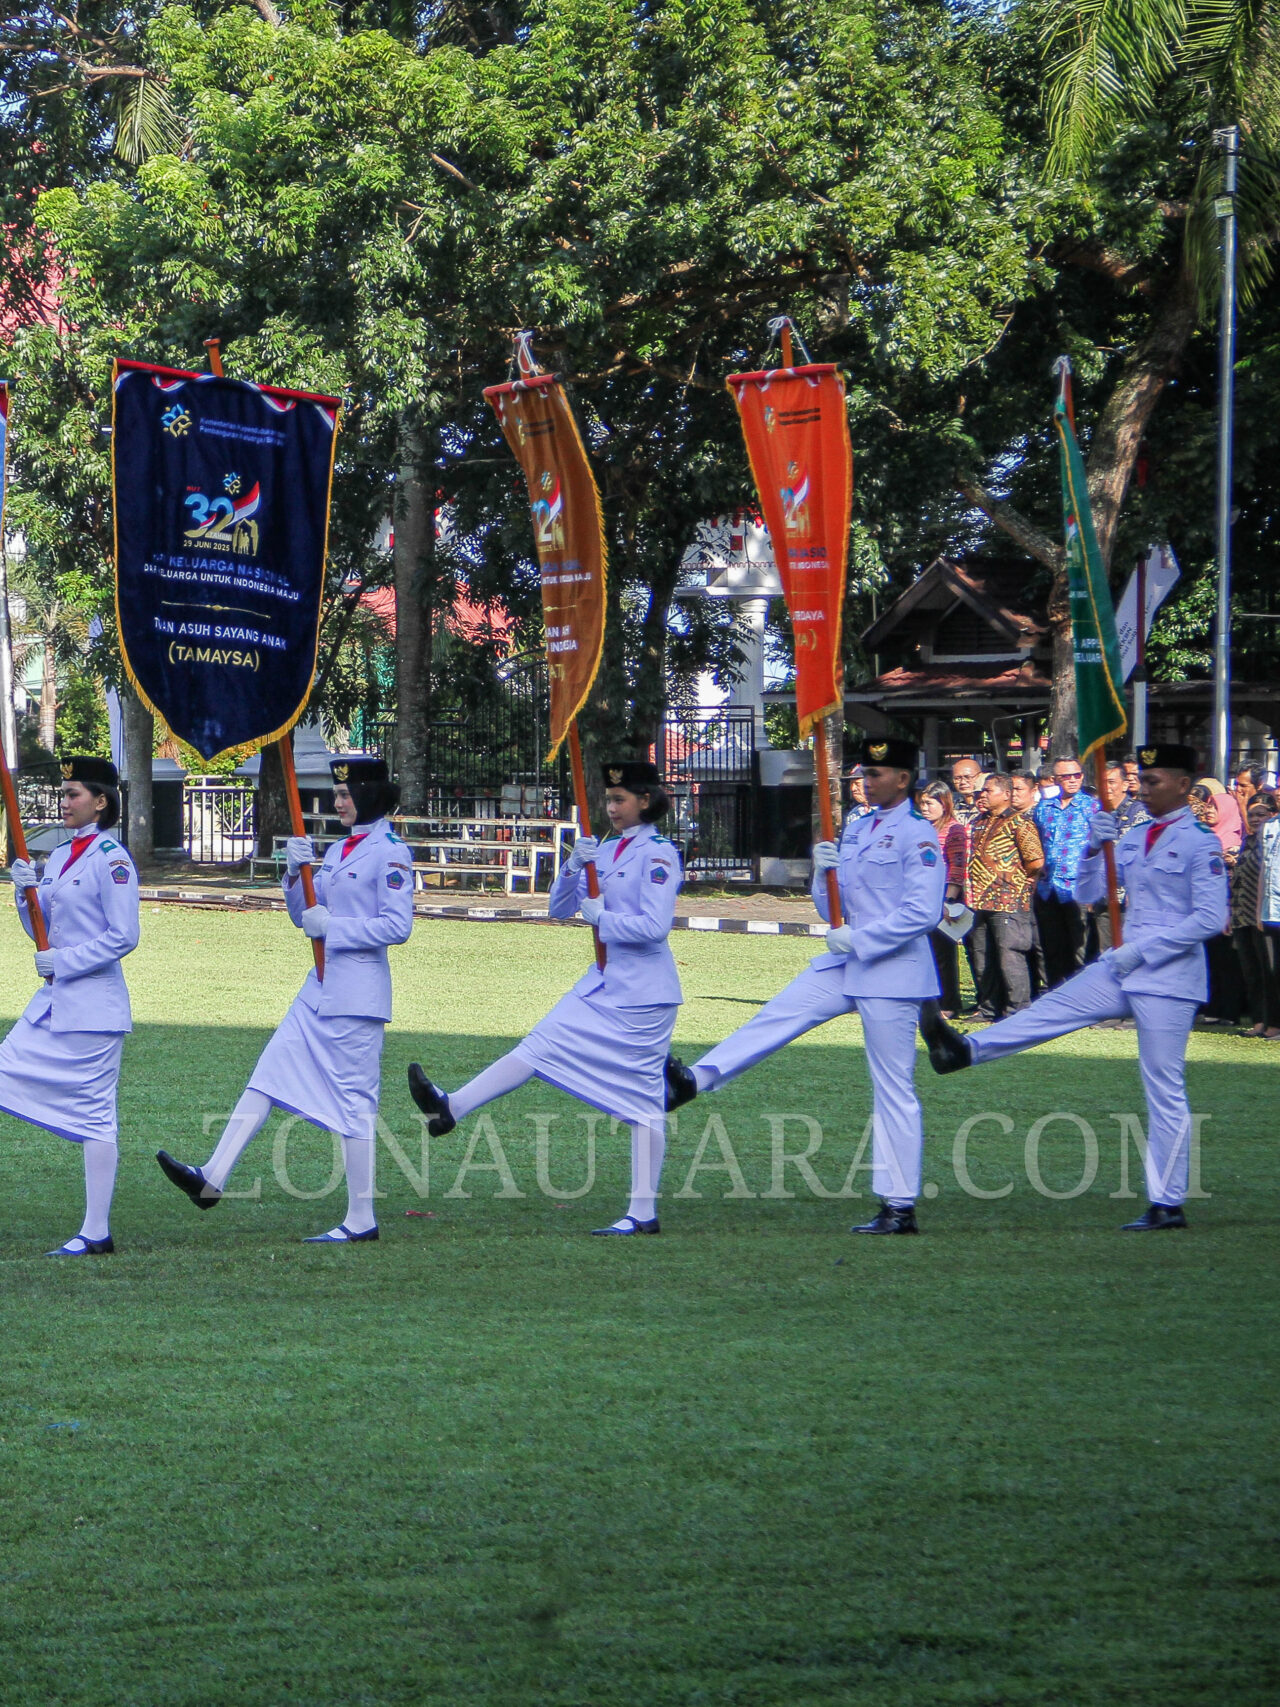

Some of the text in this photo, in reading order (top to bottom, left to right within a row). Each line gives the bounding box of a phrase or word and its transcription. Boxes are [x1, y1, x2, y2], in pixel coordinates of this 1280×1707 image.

[194, 541, 212, 549] JUNI
[213, 542, 230, 552] 2025
[169, 555, 235, 573] KELUARGA
[200, 573, 232, 584] UNTUK
[233, 577, 276, 594] INDONESIA
[276, 588, 300, 600] MAJU
[179, 623, 211, 636] ASUH
[214, 626, 260, 642] SAYANG
[261, 633, 287, 651] ANAK
[168, 640, 261, 673] (TAMAYSA)
